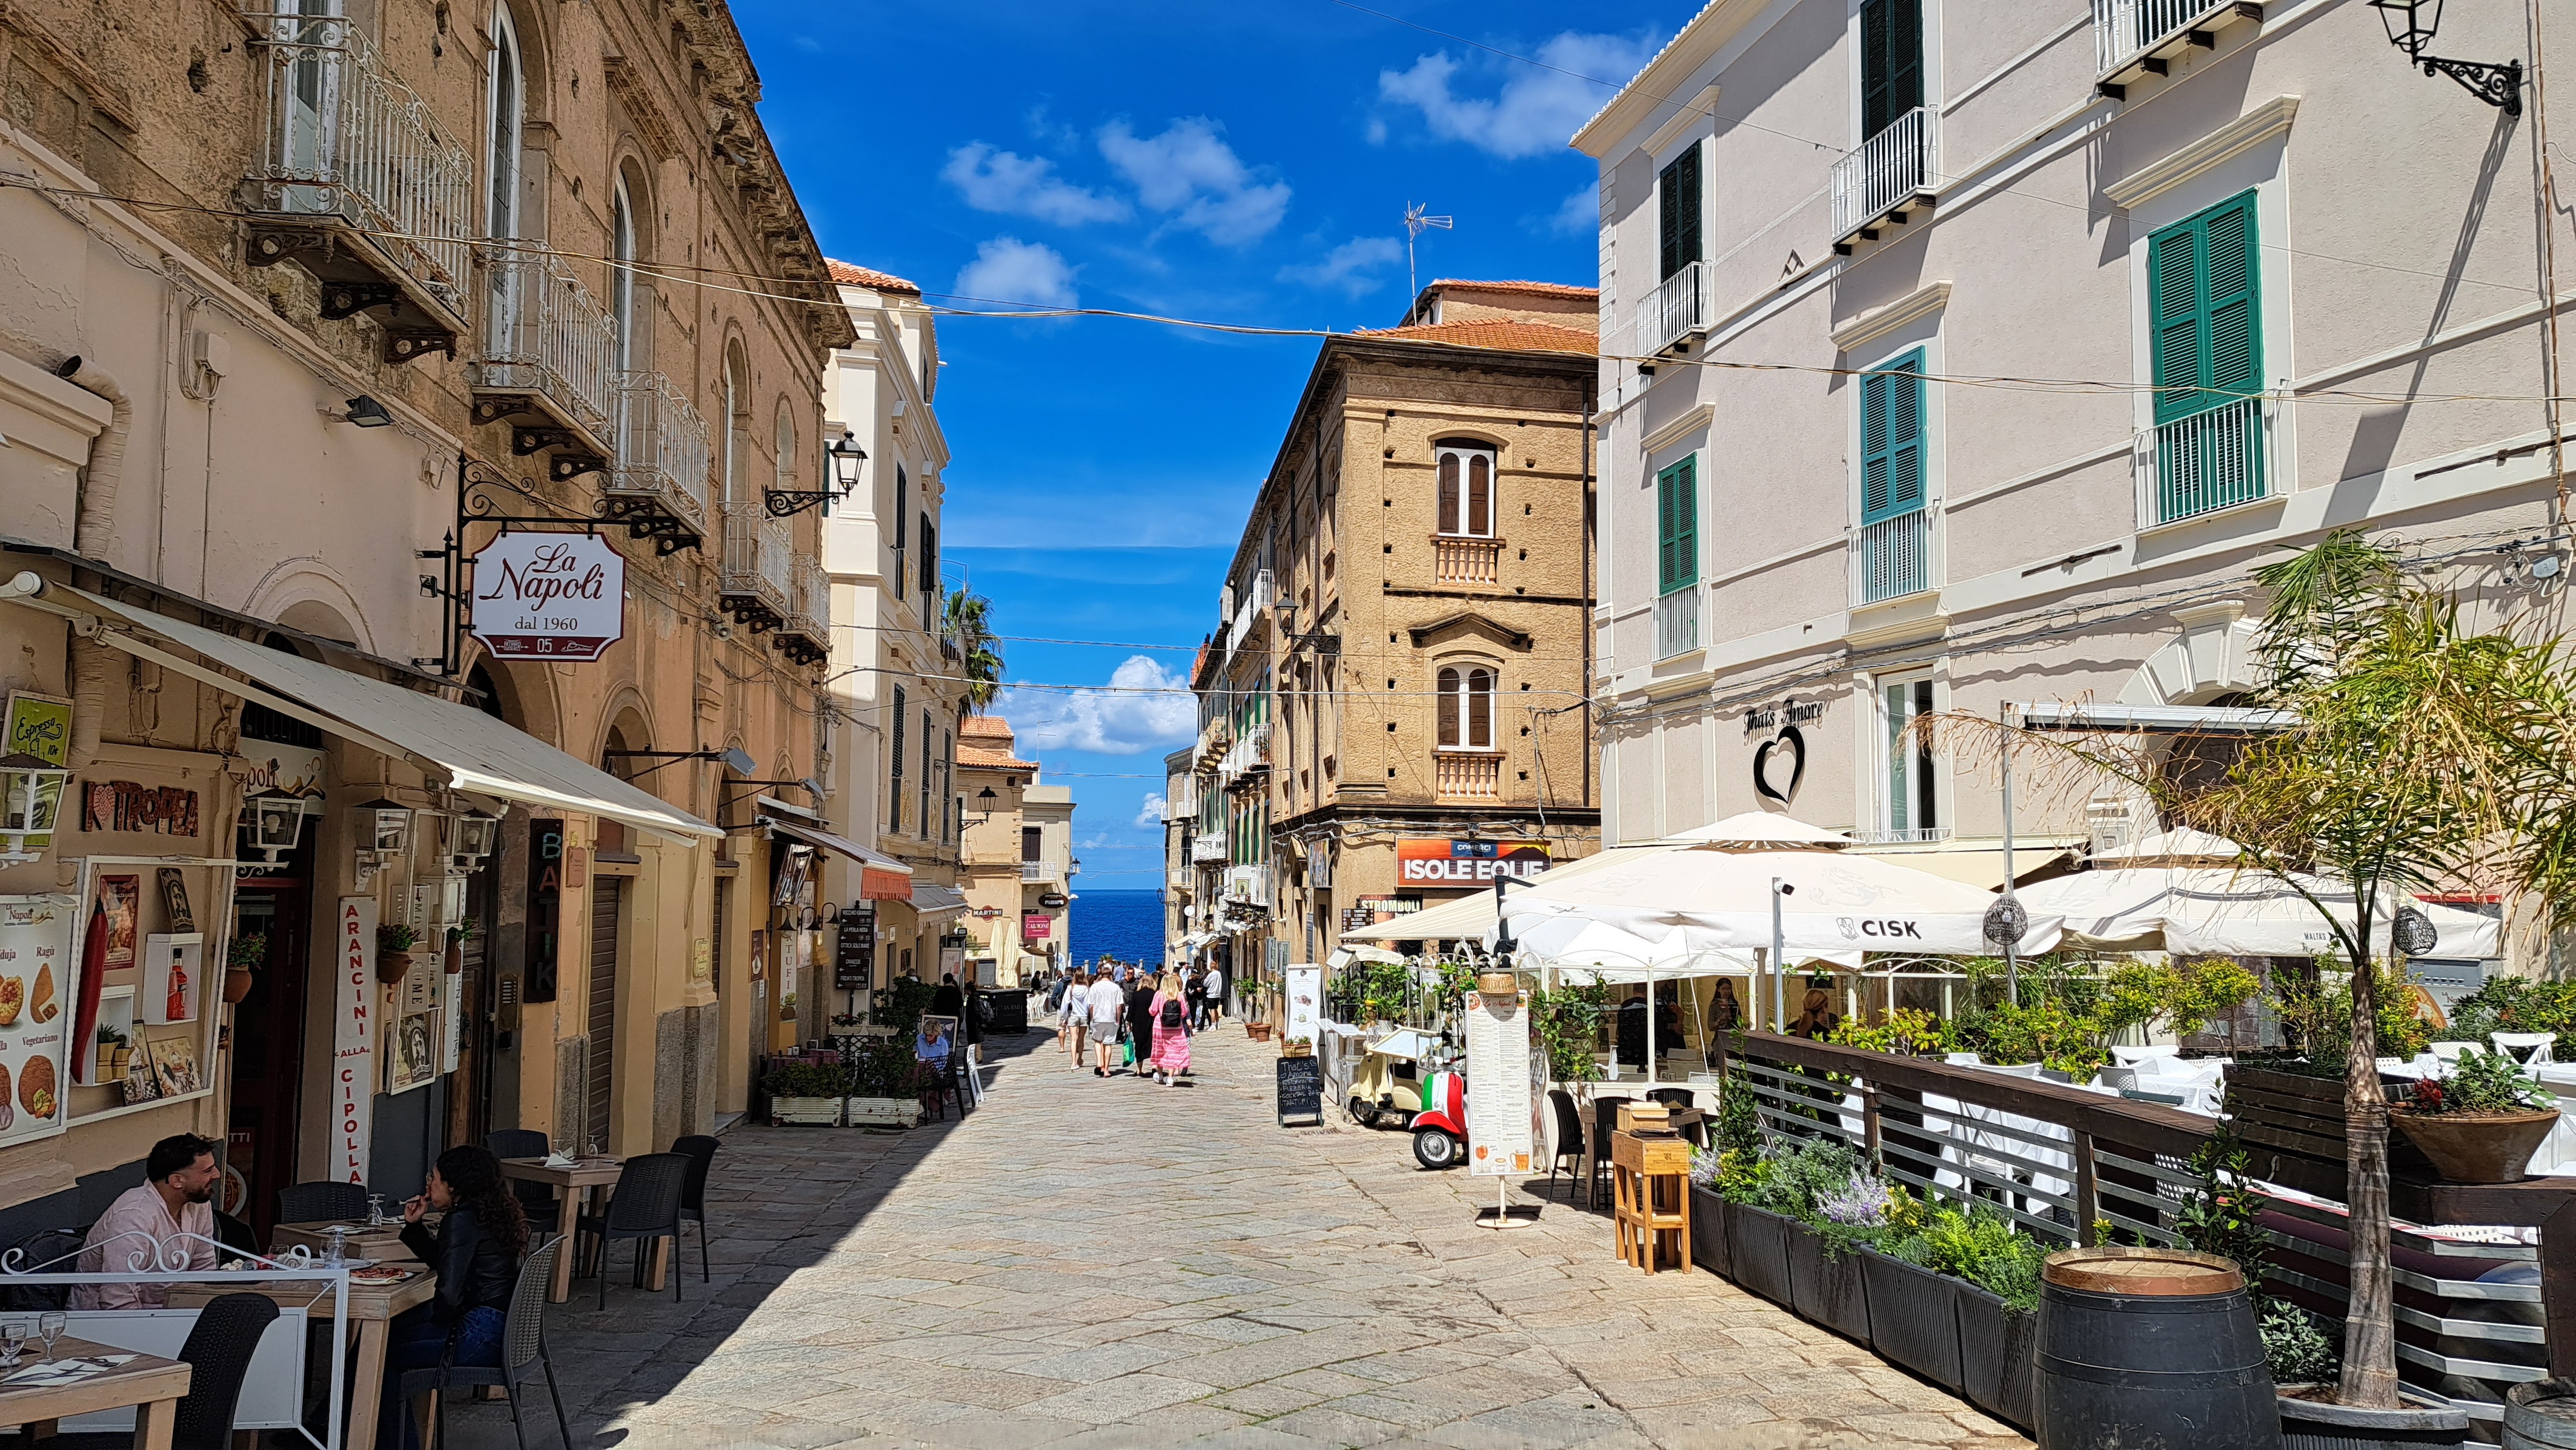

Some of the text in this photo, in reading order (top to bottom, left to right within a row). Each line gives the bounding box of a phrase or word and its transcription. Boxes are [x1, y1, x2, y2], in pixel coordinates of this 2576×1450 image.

[532, 543, 576, 573] La
[479, 558, 605, 611] Napoli
[514, 616, 578, 631] dal 1960
[537, 638, 553, 652] 05
[1744, 699, 1823, 736] That's Amore
[16, 717, 56, 741] Espresso
[245, 758, 279, 793] poli
[113, 780, 199, 837] TROPEA
[1457, 844, 1491, 852] COMERCI
[1404, 859, 1472, 880] ISOLE
[9, 910, 33, 921] Napoli
[536, 832, 562, 990] BATIK
[1361, 899, 1420, 912] STROMBOLI
[1862, 920, 1922, 940] CISK
[2304, 932, 2326, 941] MALTA'S
[0, 945, 55, 962] duja Ragù
[345, 904, 367, 1037] ARANCINI
[22, 1034, 58, 1047] Vegetariano
[340, 1046, 367, 1059] ALLA
[1281, 1061, 1310, 1072] That's
[340, 1068, 362, 1185] CIPOLLA
